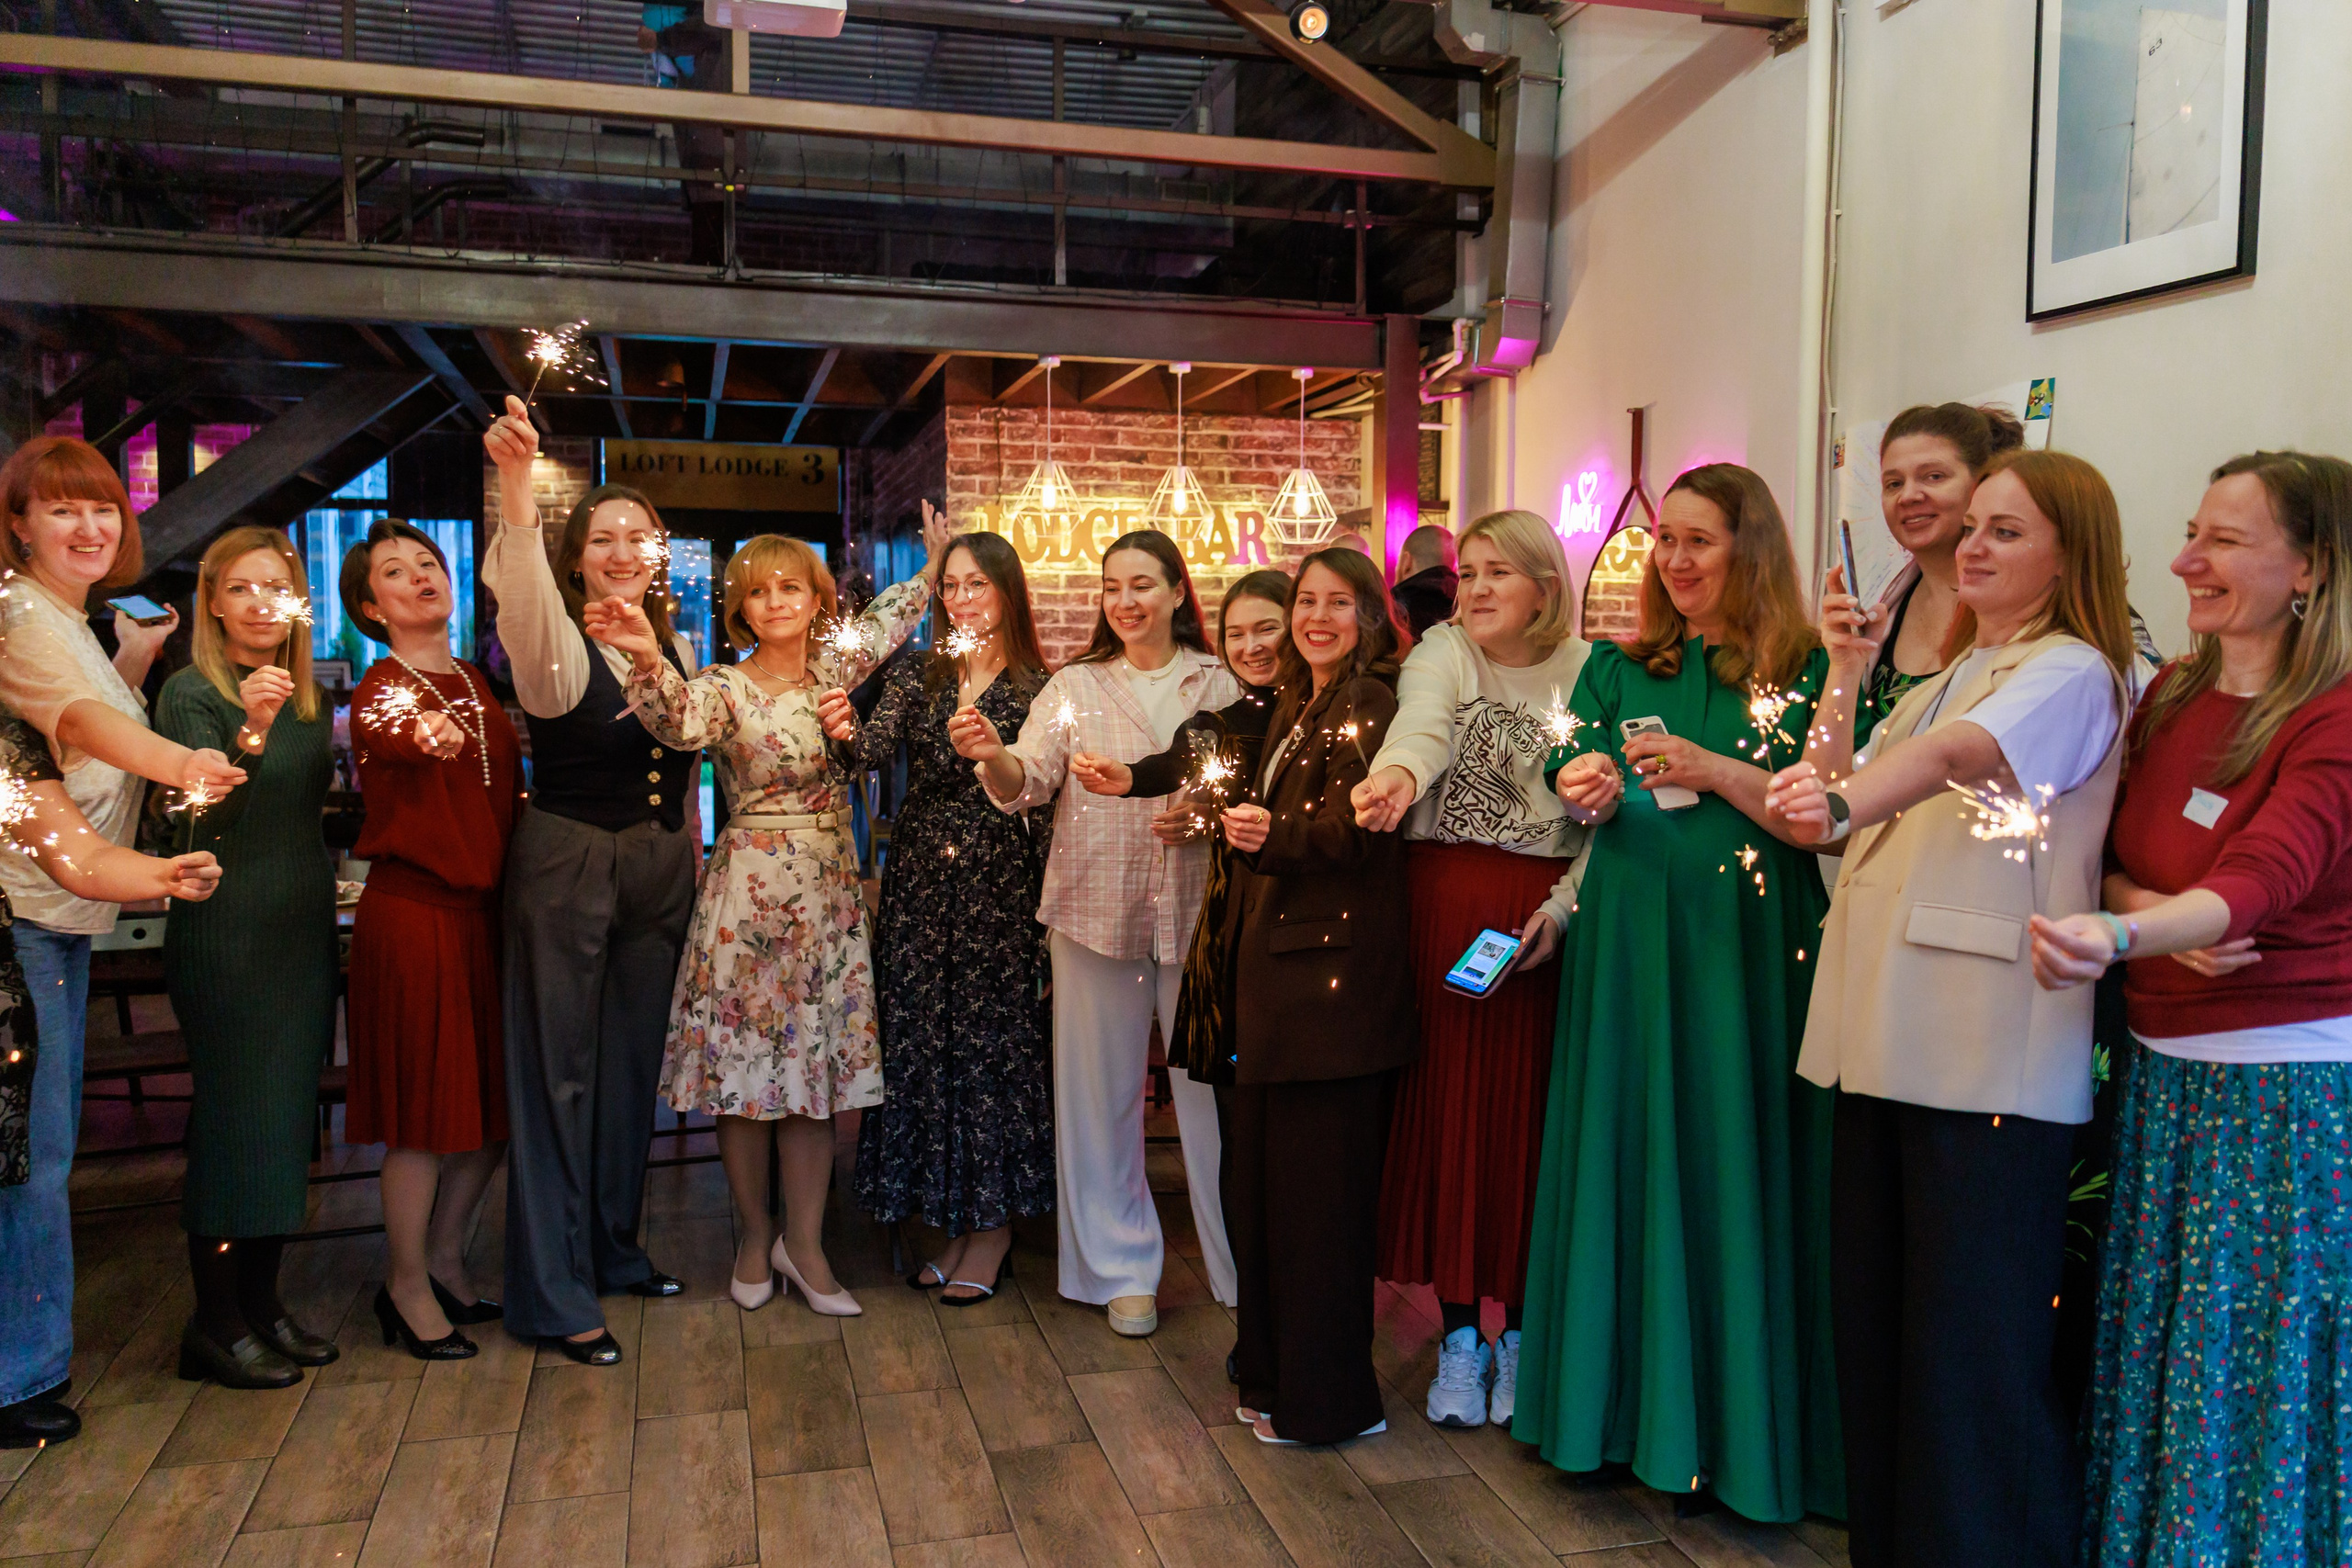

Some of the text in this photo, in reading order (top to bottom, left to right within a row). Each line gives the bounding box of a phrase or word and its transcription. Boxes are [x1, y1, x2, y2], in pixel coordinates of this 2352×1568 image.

[2148, 38, 2163, 56] 63
[619, 452, 825, 485] LOFT LODGE 3
[1174, 507, 1271, 566] BAR
